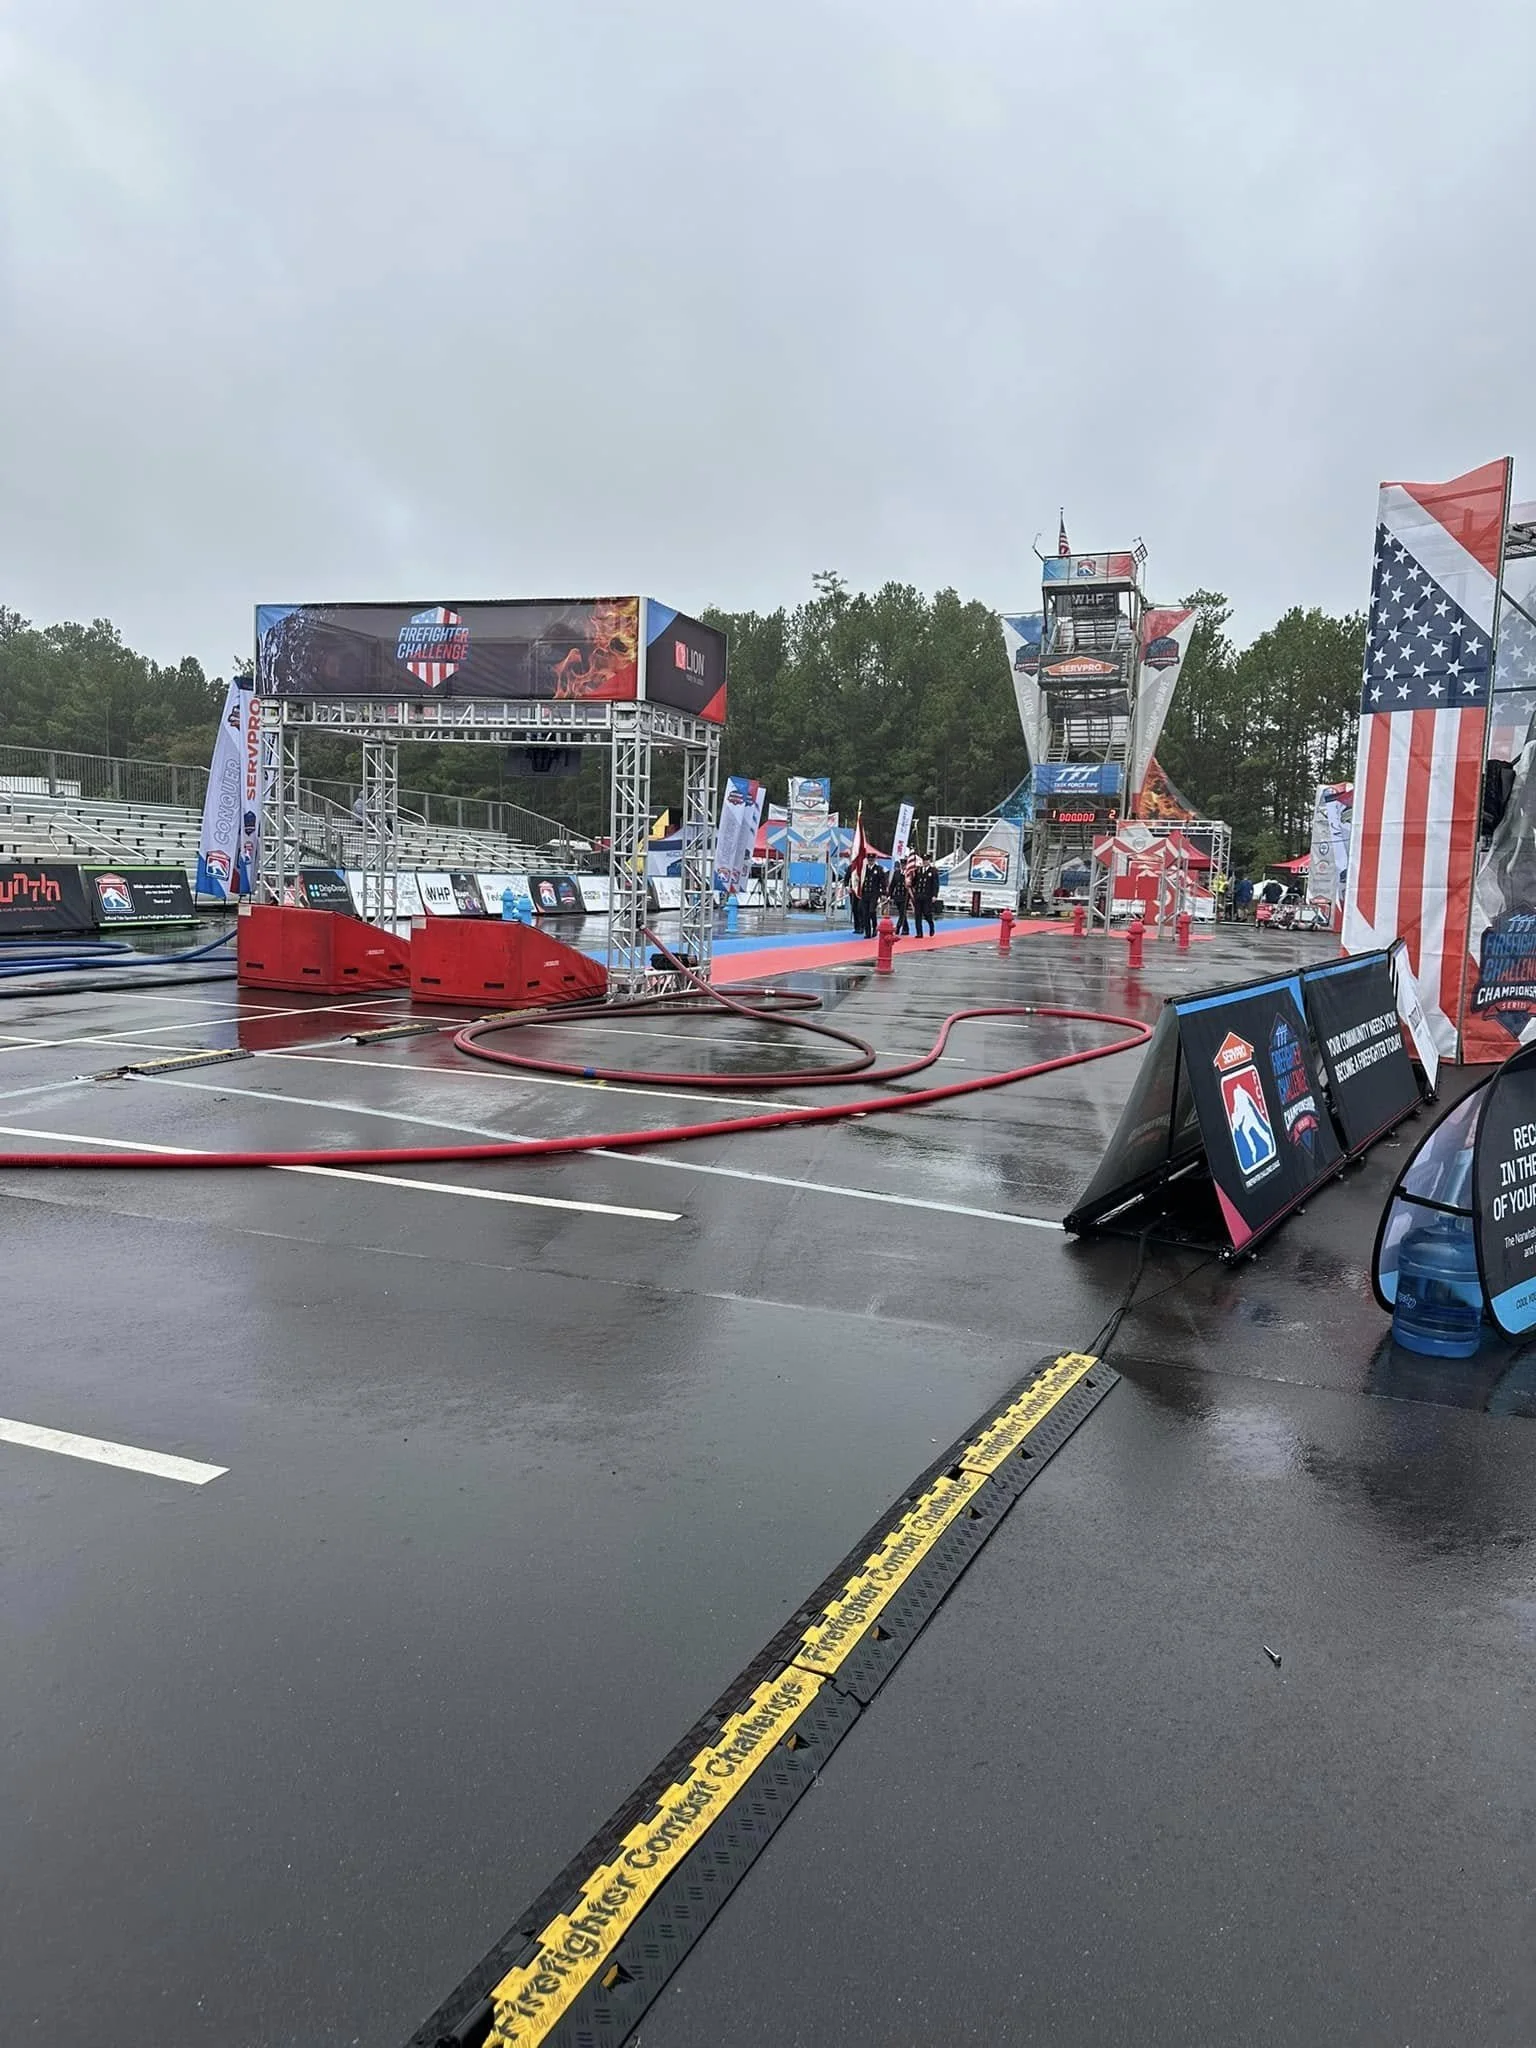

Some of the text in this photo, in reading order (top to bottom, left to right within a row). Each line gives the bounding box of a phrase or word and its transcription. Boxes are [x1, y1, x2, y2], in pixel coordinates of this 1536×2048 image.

[397, 626, 470, 643] FIREFIGHTER
[396, 643, 470, 660] CHALLENGE
[686, 647, 705, 676] LION
[1059, 663, 1103, 673] SERVPRO
[246, 698, 261, 801] SERVPRO
[214, 758, 241, 845] CONQUER
[1108, 809, 1116, 819] 2
[319, 884, 347, 895] DripDrop
[428, 886, 451, 902] WHP
[1482, 957, 1536, 982] CHALLEN
[1326, 1035, 1343, 1057] YOUR
[1339, 1021, 1371, 1051] COMMUNITY
[1367, 1015, 1386, 1037] NEEDS
[1334, 1056, 1357, 1084] BECOME
[1356, 1040, 1388, 1071] FIREFIGHTER
[1500, 1159, 1516, 1187] IN
[1493, 1193, 1508, 1222] OF
[1504, 1236, 1515, 1249] The
[1523, 1244, 1534, 1258] and
[967, 1357, 1086, 1467] Firefighter Combat Challenge
[800, 1476, 972, 1663] Firefighter Combat Challenge
[623, 1780, 722, 1870] Combat
[704, 1681, 804, 1778] Challenge
